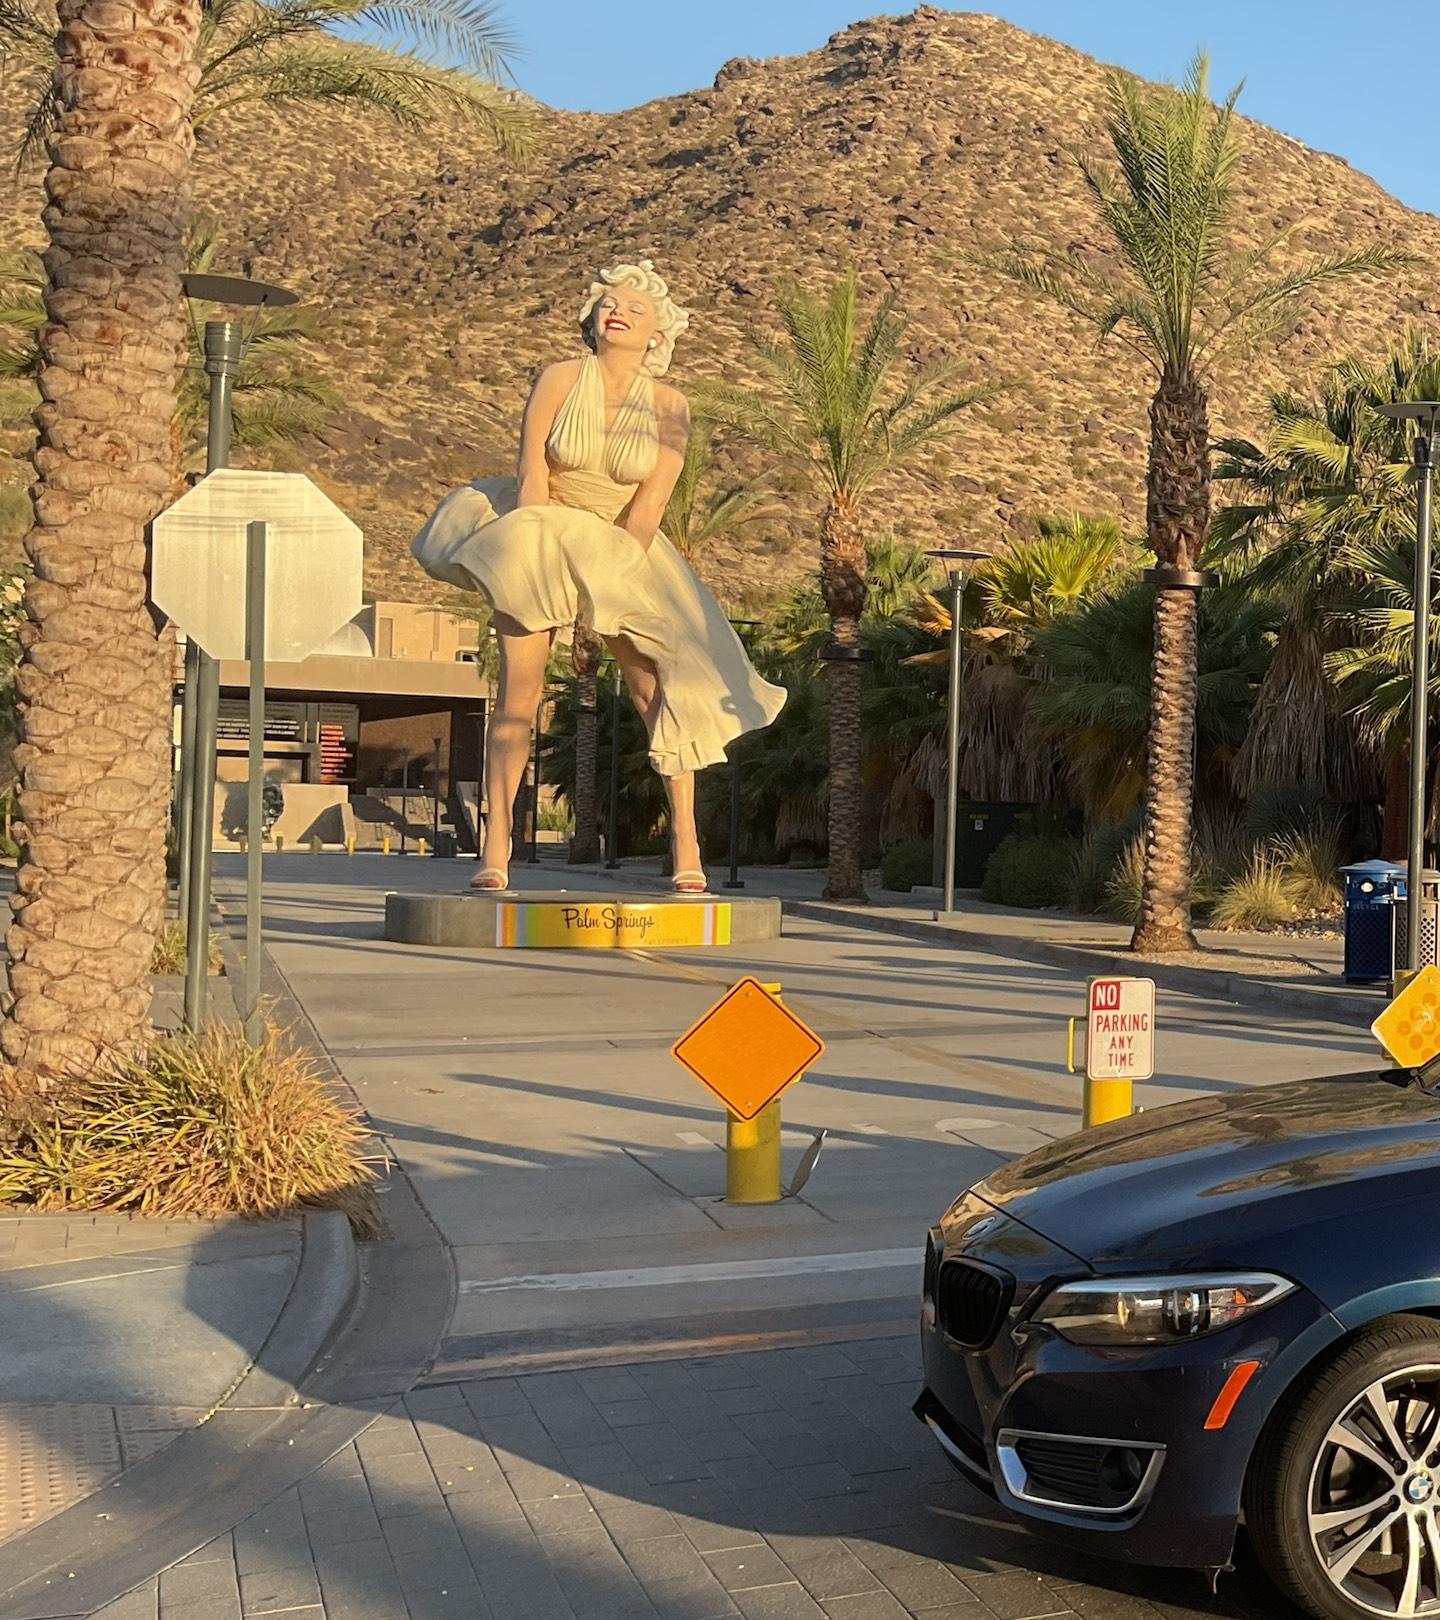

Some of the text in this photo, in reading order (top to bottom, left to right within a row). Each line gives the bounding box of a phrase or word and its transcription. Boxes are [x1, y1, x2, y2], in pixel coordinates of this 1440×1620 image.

[561, 907, 655, 938] Palm Springs
[1096, 985, 1117, 1006] NO
[1096, 1013, 1148, 1032] PARKING
[1109, 1036, 1133, 1049] ANY
[1108, 1053, 1134, 1067] TIME
